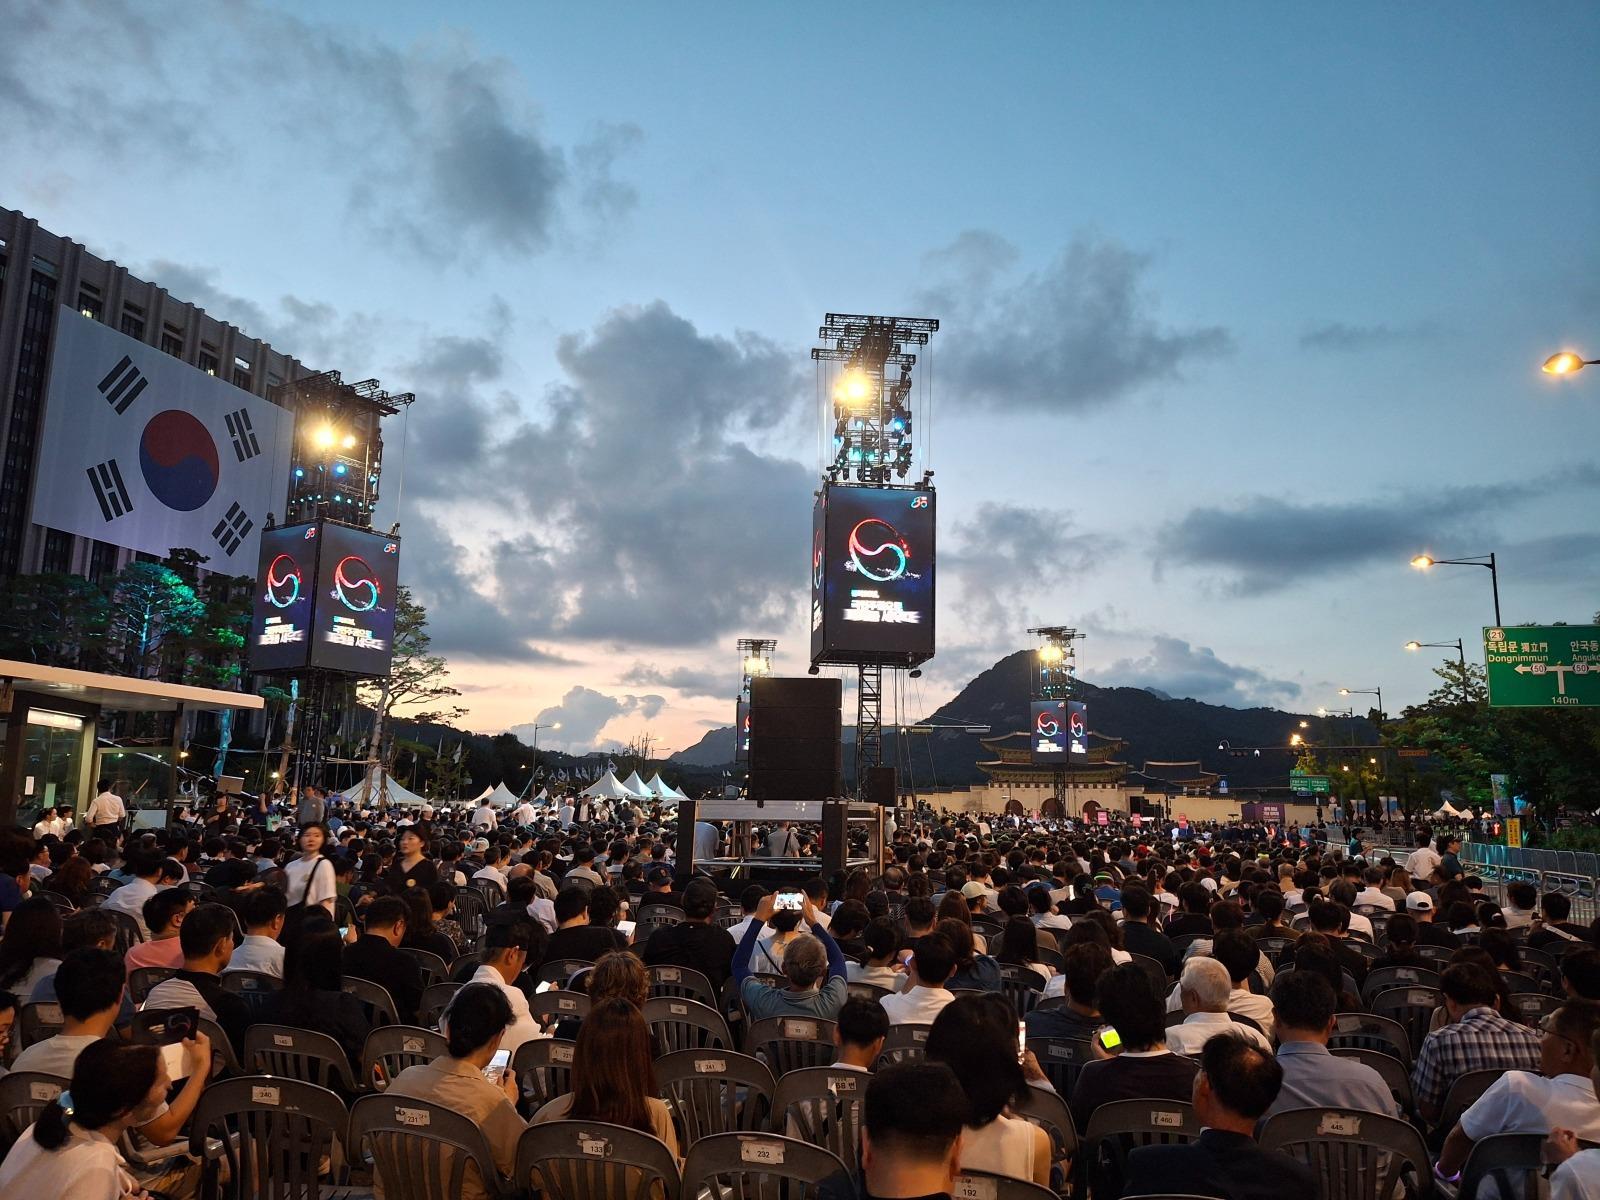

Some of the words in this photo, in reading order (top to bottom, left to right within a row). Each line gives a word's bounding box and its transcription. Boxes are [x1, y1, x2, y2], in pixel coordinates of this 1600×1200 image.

[1487, 641, 1518, 653] 독립문
[1570, 640, 1599, 652] 안국동
[1488, 655, 1549, 663] Dongnimmun
[1552, 696, 1579, 705] 140m
[962, 1188, 977, 1197] 192
